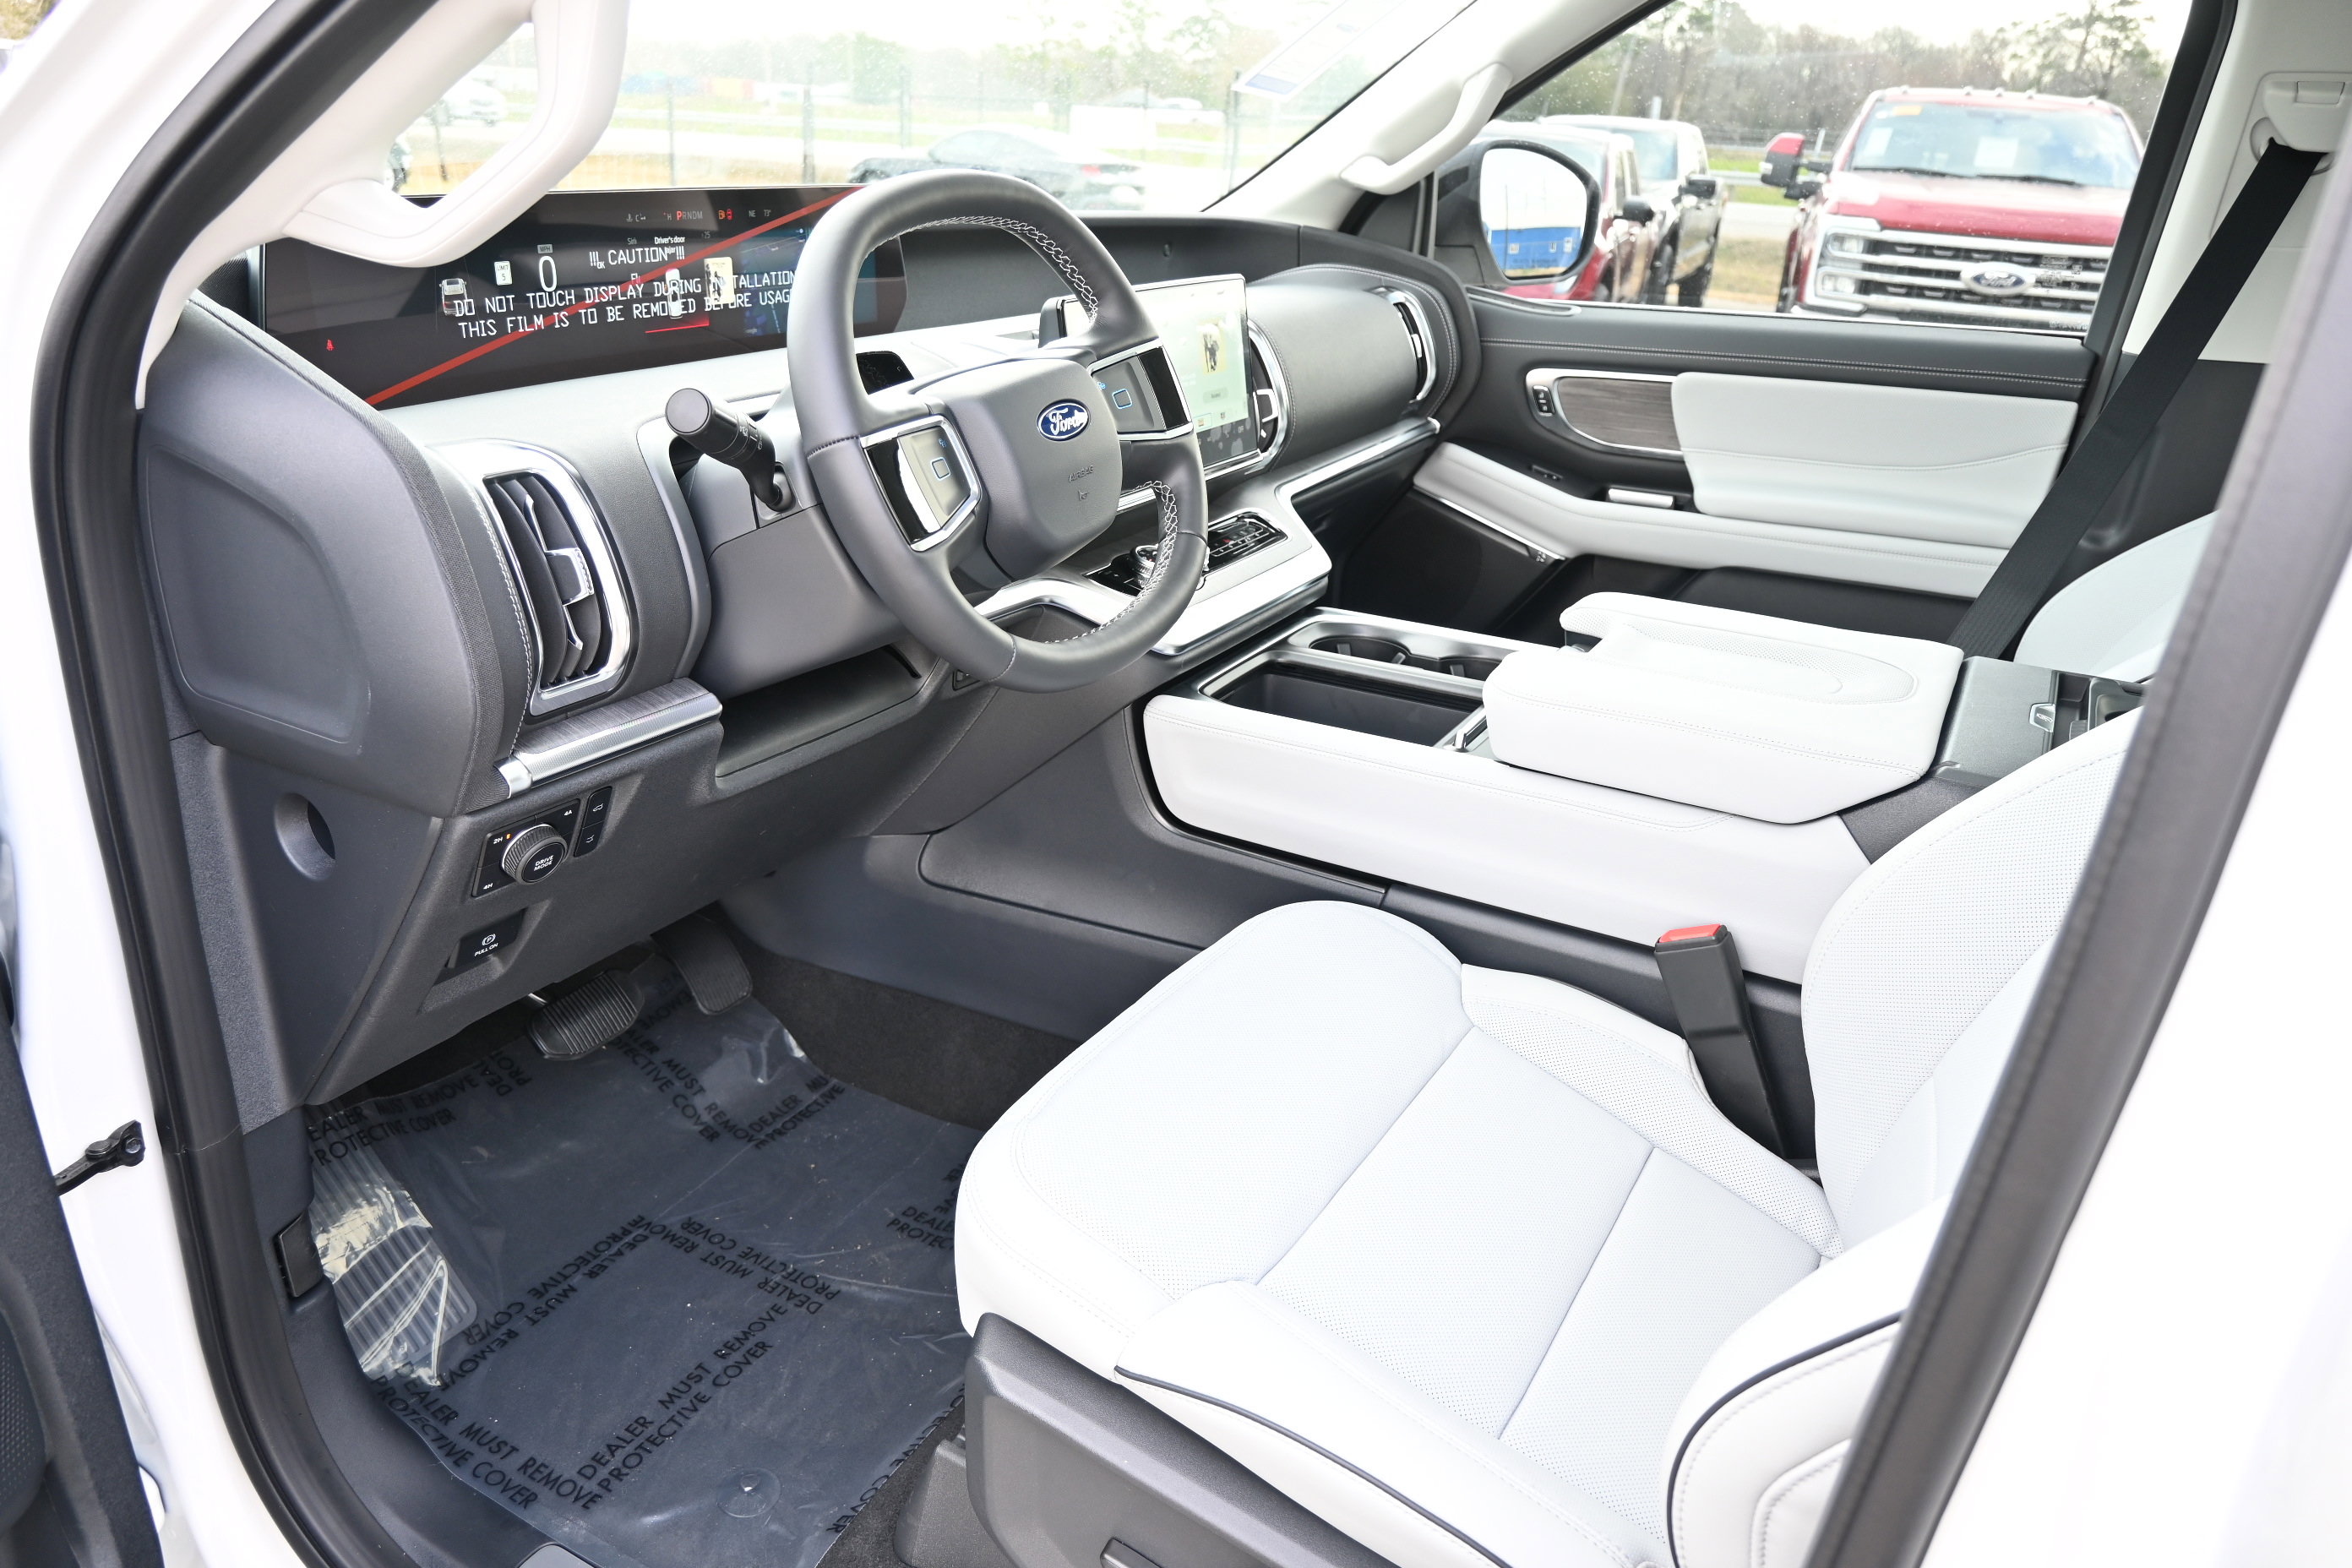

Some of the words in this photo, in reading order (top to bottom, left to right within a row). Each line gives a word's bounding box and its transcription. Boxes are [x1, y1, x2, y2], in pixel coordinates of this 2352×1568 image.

[608, 247, 668, 265] CAUTION
[654, 237, 674, 245] Driver's
[539, 255, 558, 292] 0
[454, 298, 476, 318] DO
[485, 295, 515, 314] NOT
[526, 289, 575, 309] TOUCH
[584, 283, 645, 304] DISPLAY
[653, 278, 702, 297] DURING
[458, 319, 498, 339] THIS
[507, 314, 545, 334] FILM
[553, 311, 569, 329] IS
[578, 308, 598, 325] TO
[607, 305, 625, 322] BE
[633, 298, 696, 319] REMOED
[760, 289, 791, 306] USAG
[493, 836, 504, 845] 2H
[535, 855, 554, 867] DRIVE
[533, 861, 553, 872] MODE
[474, 947, 488, 957] PULL
[662, 1058, 706, 1097] MUST
[409, 1108, 457, 1134] COVER
[672, 1093, 721, 1143] COVER
[748, 1093, 803, 1135] DEALER
[765, 1084, 846, 1143] PROTECTIVE
[627, 1214, 700, 1255] REMOVE
[680, 1217, 738, 1251] COVER
[526, 1225, 632, 1300] PROTECTIVE
[582, 1232, 650, 1280] DEALER
[700, 1250, 754, 1280] MUST
[738, 1245, 841, 1301] PROTECTIVE
[525, 1282, 579, 1327] MUST
[756, 1276, 825, 1315] DEALER
[464, 1301, 526, 1347] COVER
[577, 1415, 655, 1481] DEALER
[657, 1362, 712, 1410] MUST
[713, 1303, 788, 1360] REMOVE
[394, 1360, 460, 1426] DEALER
[459, 1421, 520, 1461] MUST
[516, 1456, 604, 1511] REMOVE
[596, 1391, 712, 1493] PROTECTIVE
[711, 1340, 774, 1389] COVER
[370, 1374, 474, 1468] PROTECTIVE
[471, 1461, 539, 1511] COVER
